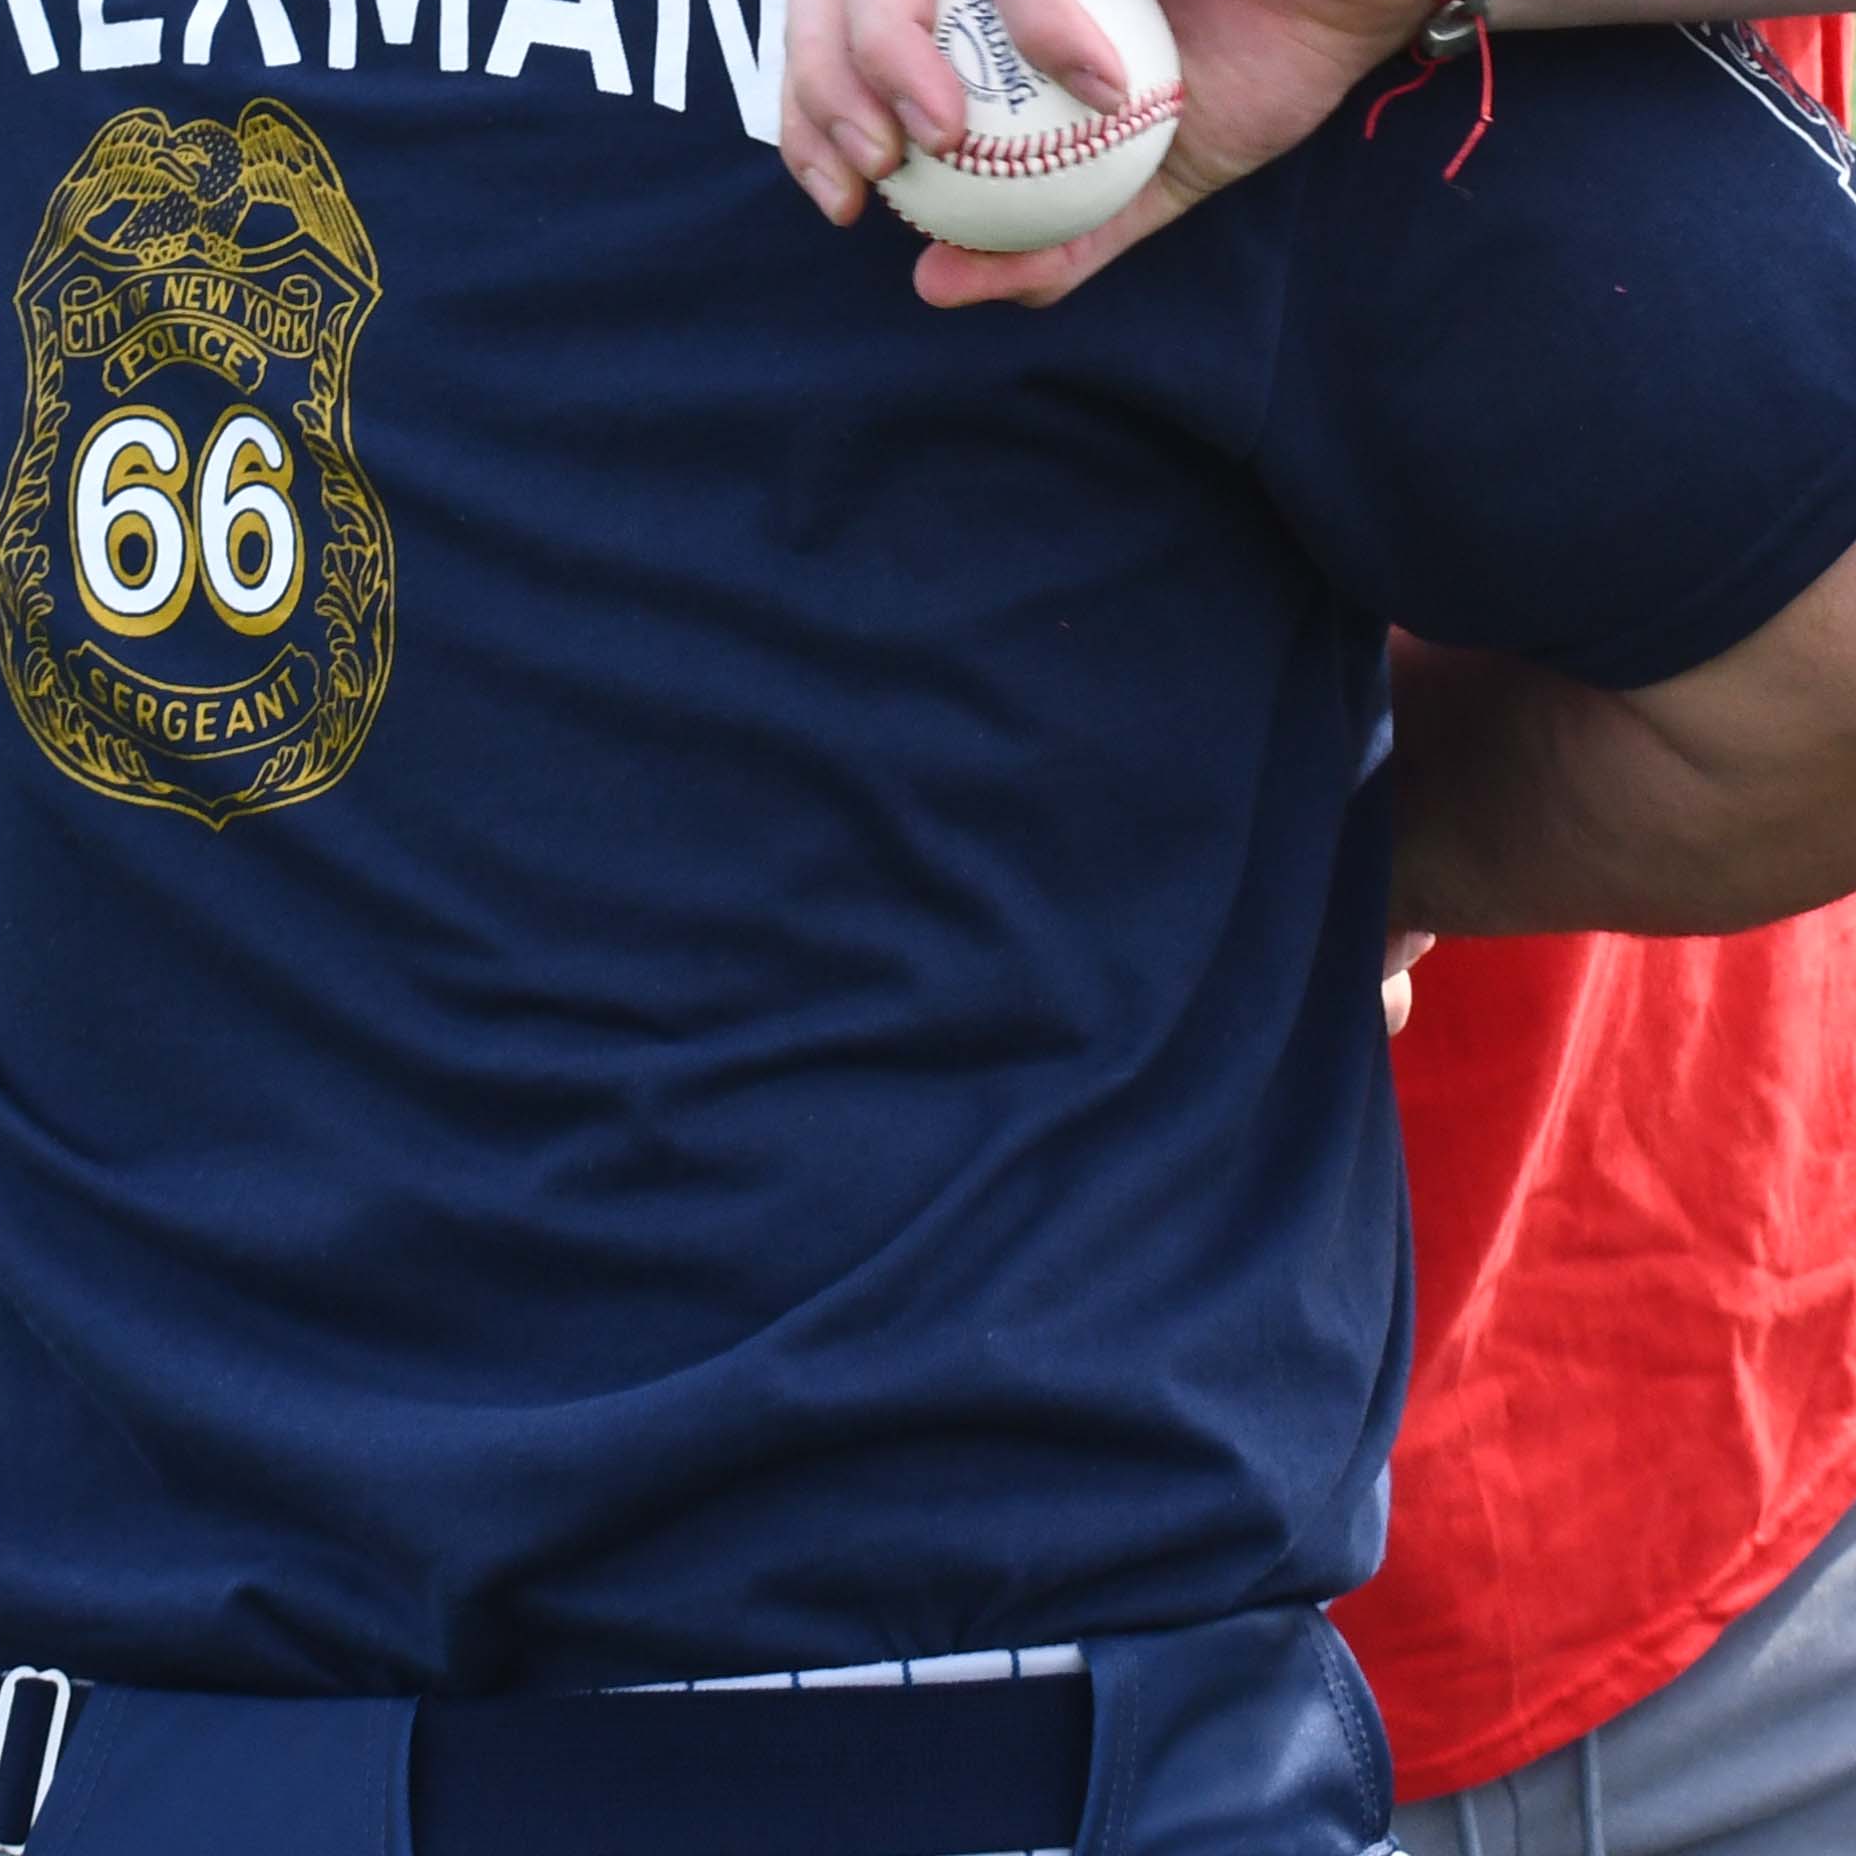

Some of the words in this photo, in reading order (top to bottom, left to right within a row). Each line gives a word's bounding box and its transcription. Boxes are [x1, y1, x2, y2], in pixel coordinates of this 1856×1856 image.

[67, 299, 122, 350] CITY
[129, 281, 152, 316] OF
[163, 276, 236, 314] NEW
[243, 288, 309, 351] YORK
[118, 325, 252, 381] POLICE
[69, 404, 305, 636] 66
[90, 666, 299, 743] SERGEANT
